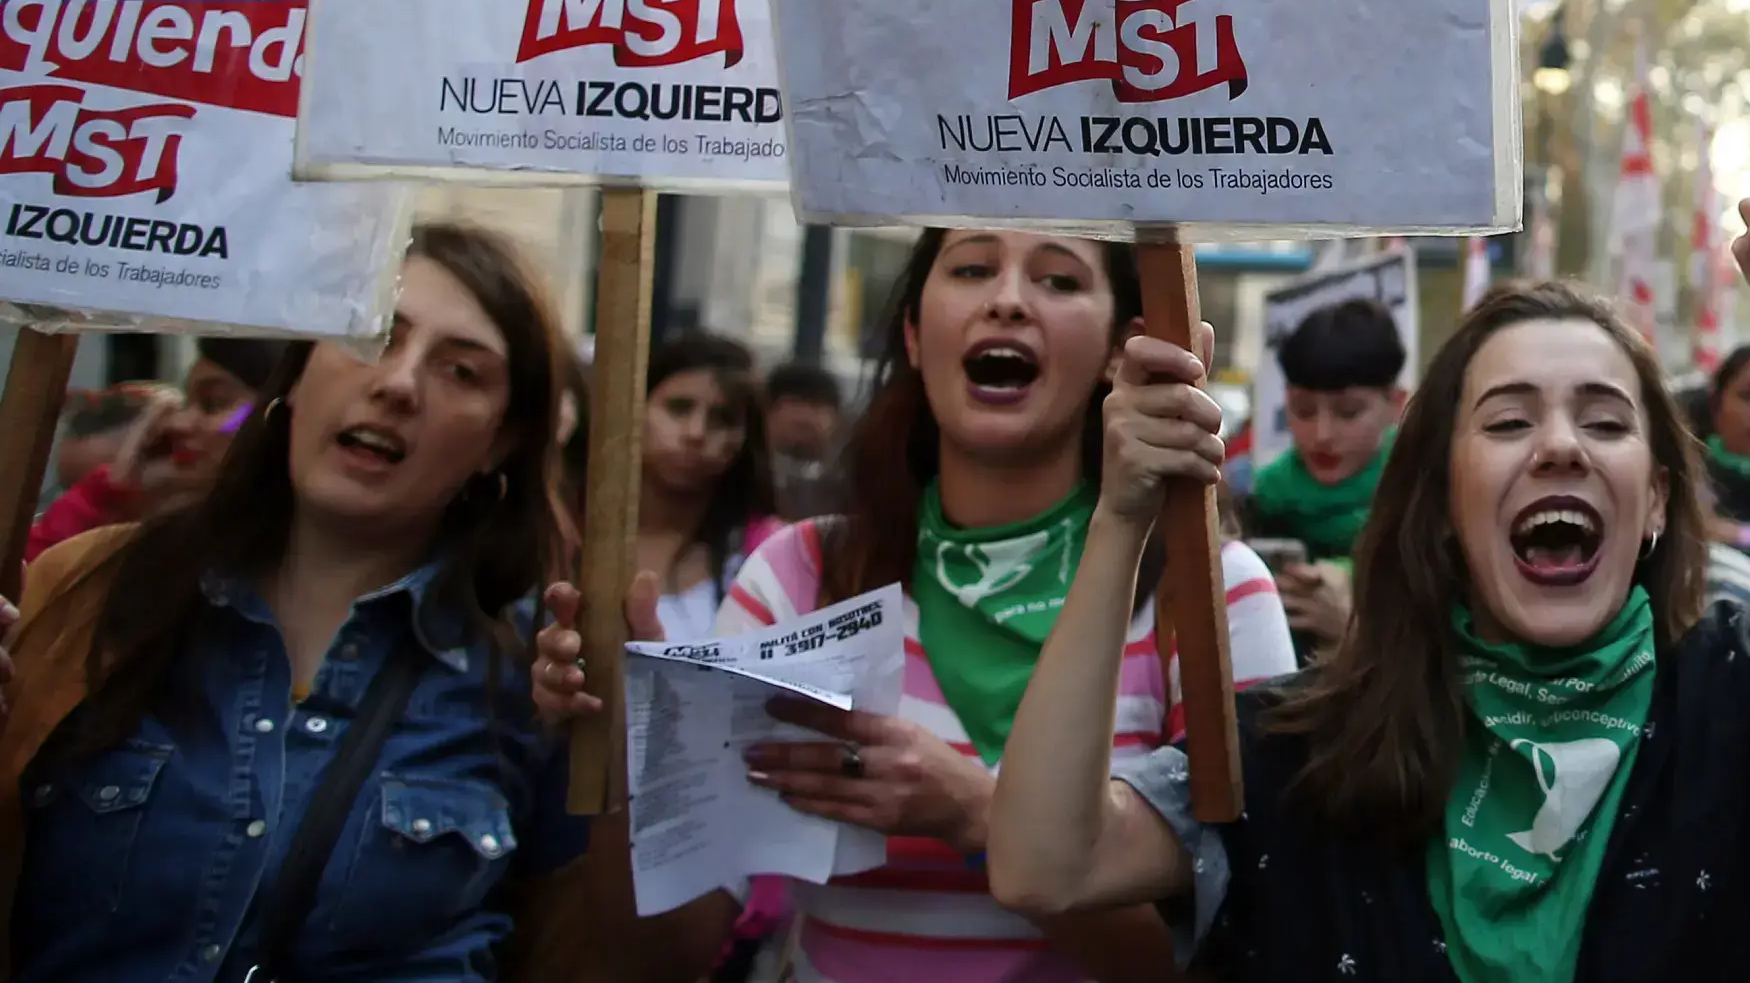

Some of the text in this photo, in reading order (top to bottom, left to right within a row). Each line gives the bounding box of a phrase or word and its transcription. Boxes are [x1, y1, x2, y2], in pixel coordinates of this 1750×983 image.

[440, 76, 783, 124] NUEVA IZQUIERD
[2, 99, 185, 189] MST
[438, 127, 784, 162] Movimiento Socialista de los Trabajado
[938, 114, 1333, 156] NUEVA IZQUIERDA
[945, 166, 1333, 195] Movimiento Socialista de los Trabajadores
[6, 203, 228, 259] IZQUIERDA
[0, 249, 220, 289] ialista de los Trabajadores
[1449, 835, 1536, 885] aborto legal
